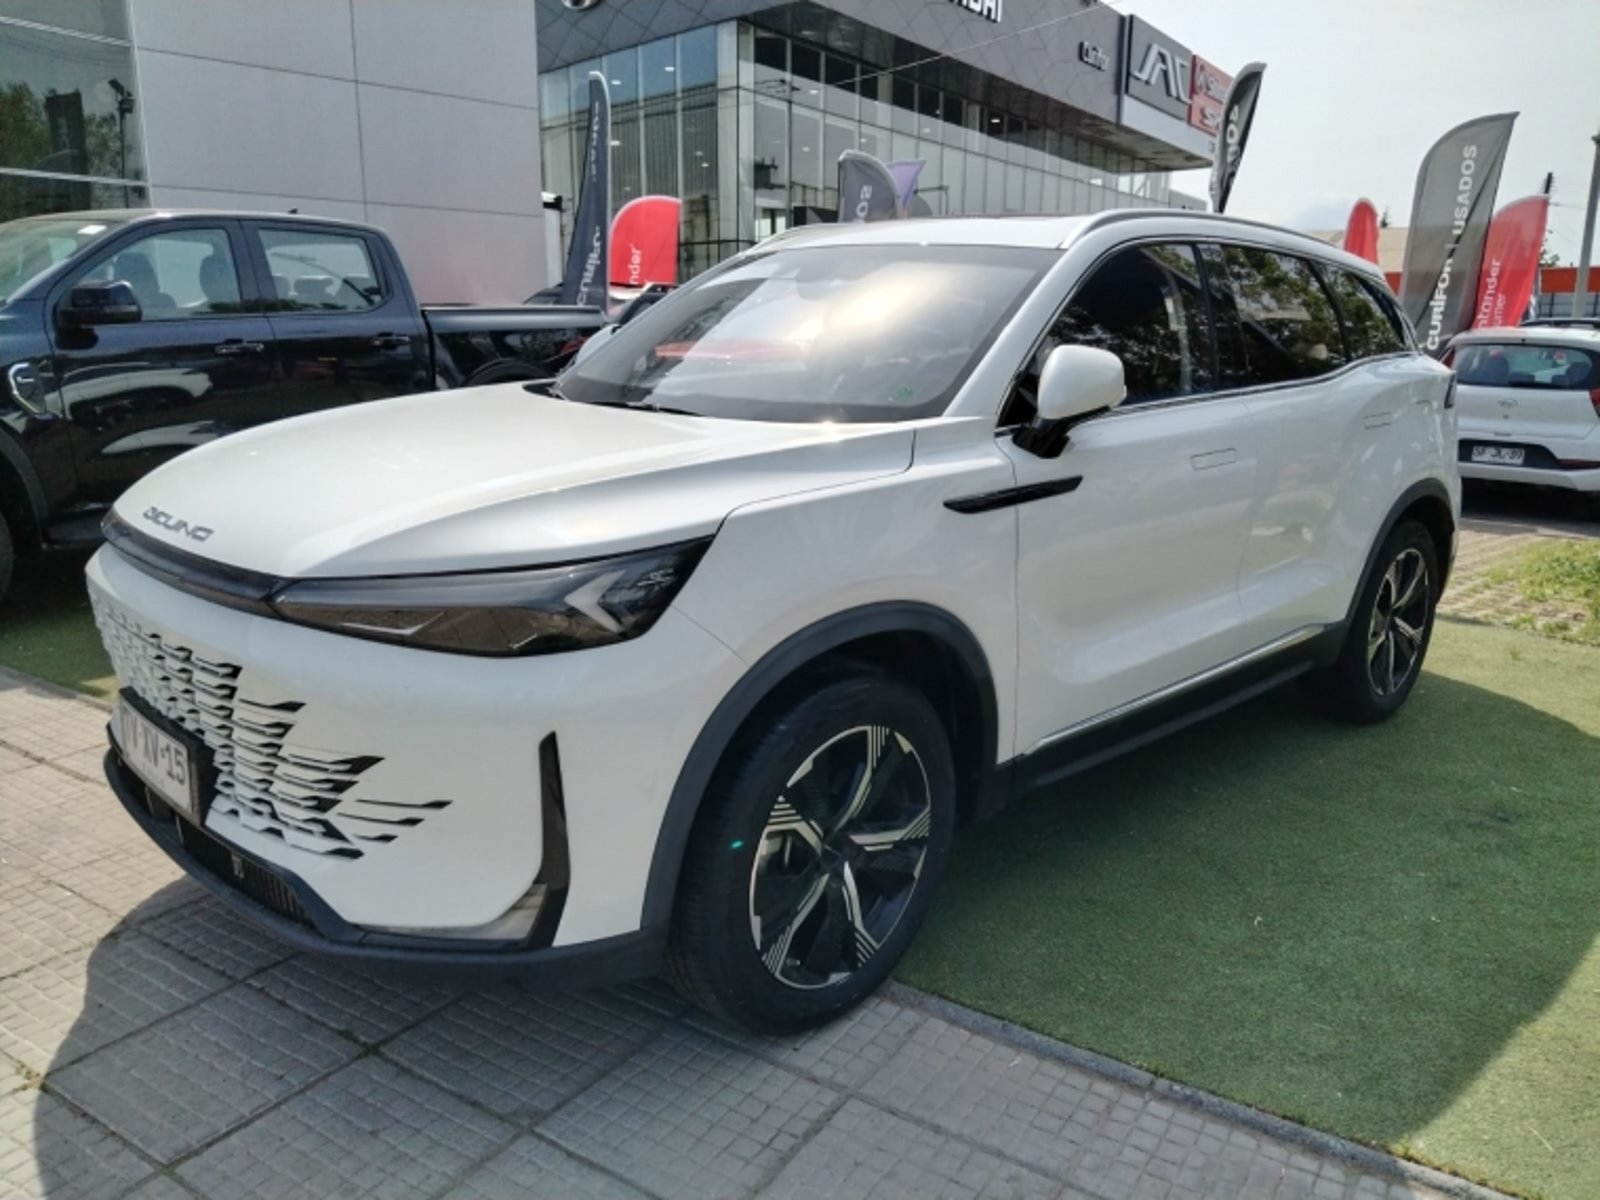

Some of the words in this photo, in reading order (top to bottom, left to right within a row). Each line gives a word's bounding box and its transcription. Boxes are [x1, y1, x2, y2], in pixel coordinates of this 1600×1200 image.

[1452, 144, 1477, 235] USADOS
[629, 247, 643, 286] nder
[1477, 258, 1501, 328] ntander
